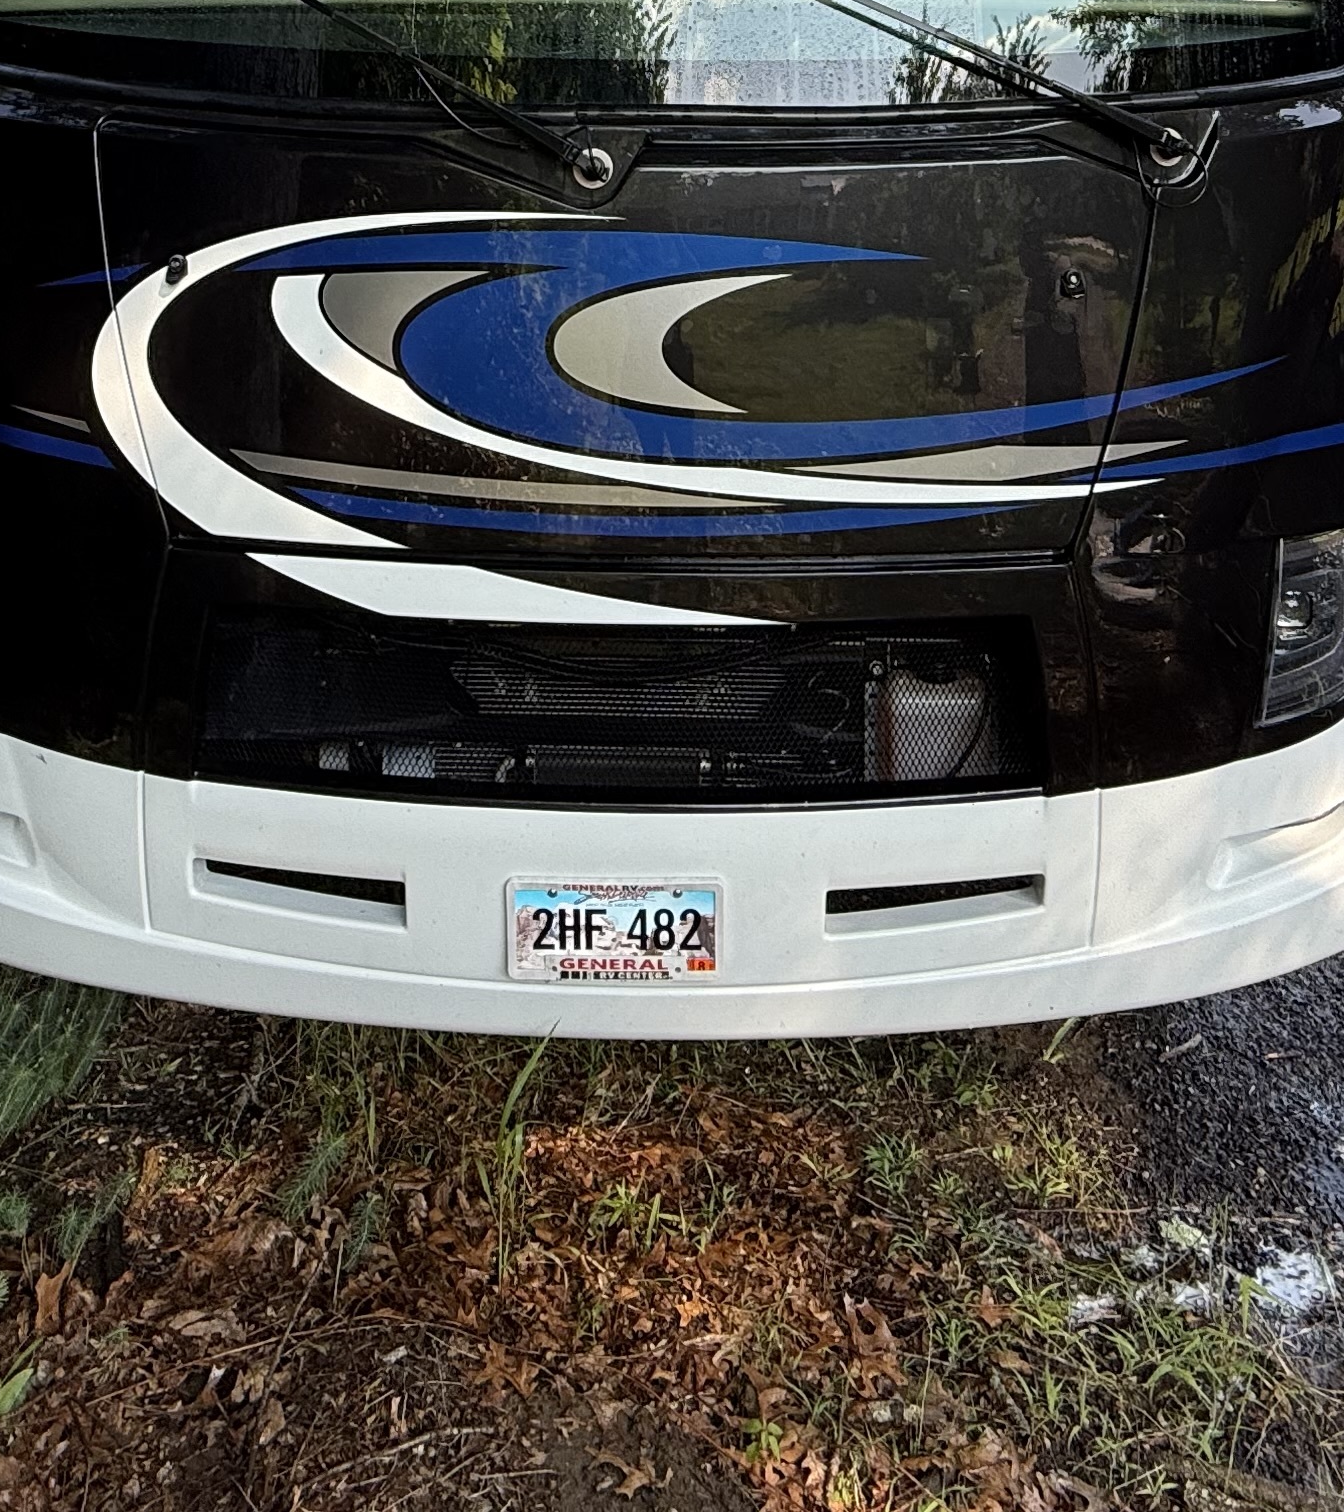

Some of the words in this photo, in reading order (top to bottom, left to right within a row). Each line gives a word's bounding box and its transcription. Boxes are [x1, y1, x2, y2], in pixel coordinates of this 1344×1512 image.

[532, 908, 607, 951] 2HF
[626, 908, 702, 951] 482
[560, 958, 668, 970] GENERAL
[599, 971, 617, 980] RV
